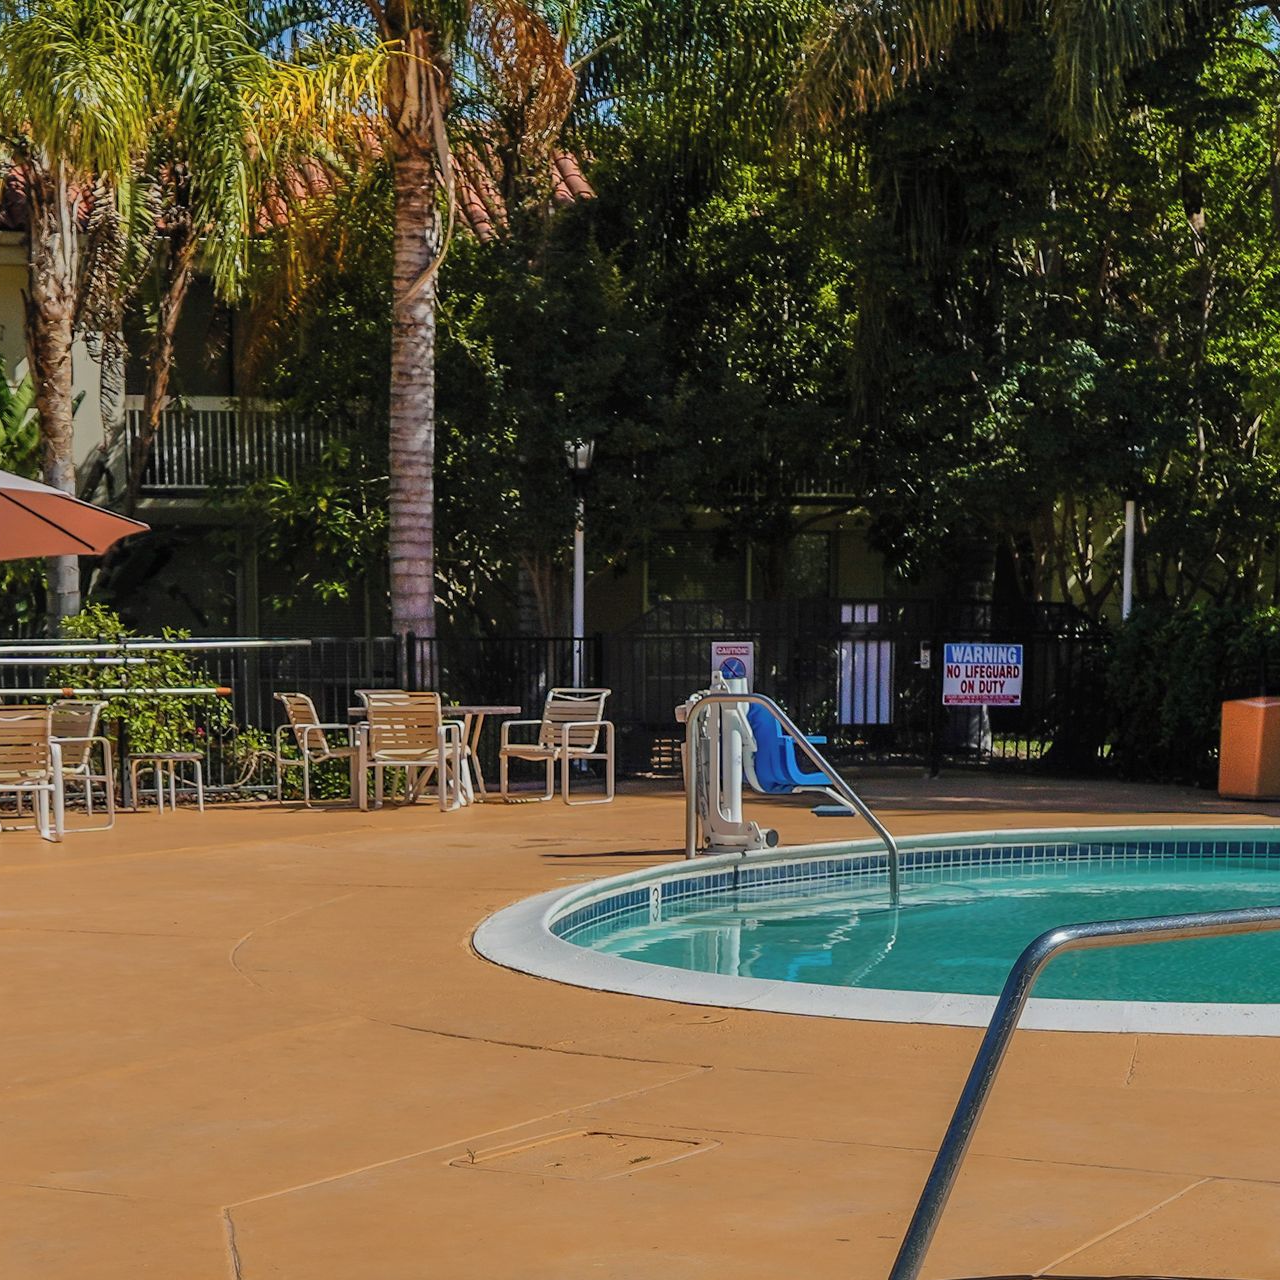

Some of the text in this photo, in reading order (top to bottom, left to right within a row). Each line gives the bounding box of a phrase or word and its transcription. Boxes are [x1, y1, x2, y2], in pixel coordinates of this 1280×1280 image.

[952, 646, 1017, 663] WARNING
[947, 665, 1020, 678] NO LIFEGUARD
[961, 680, 1005, 693] ON DUTY
